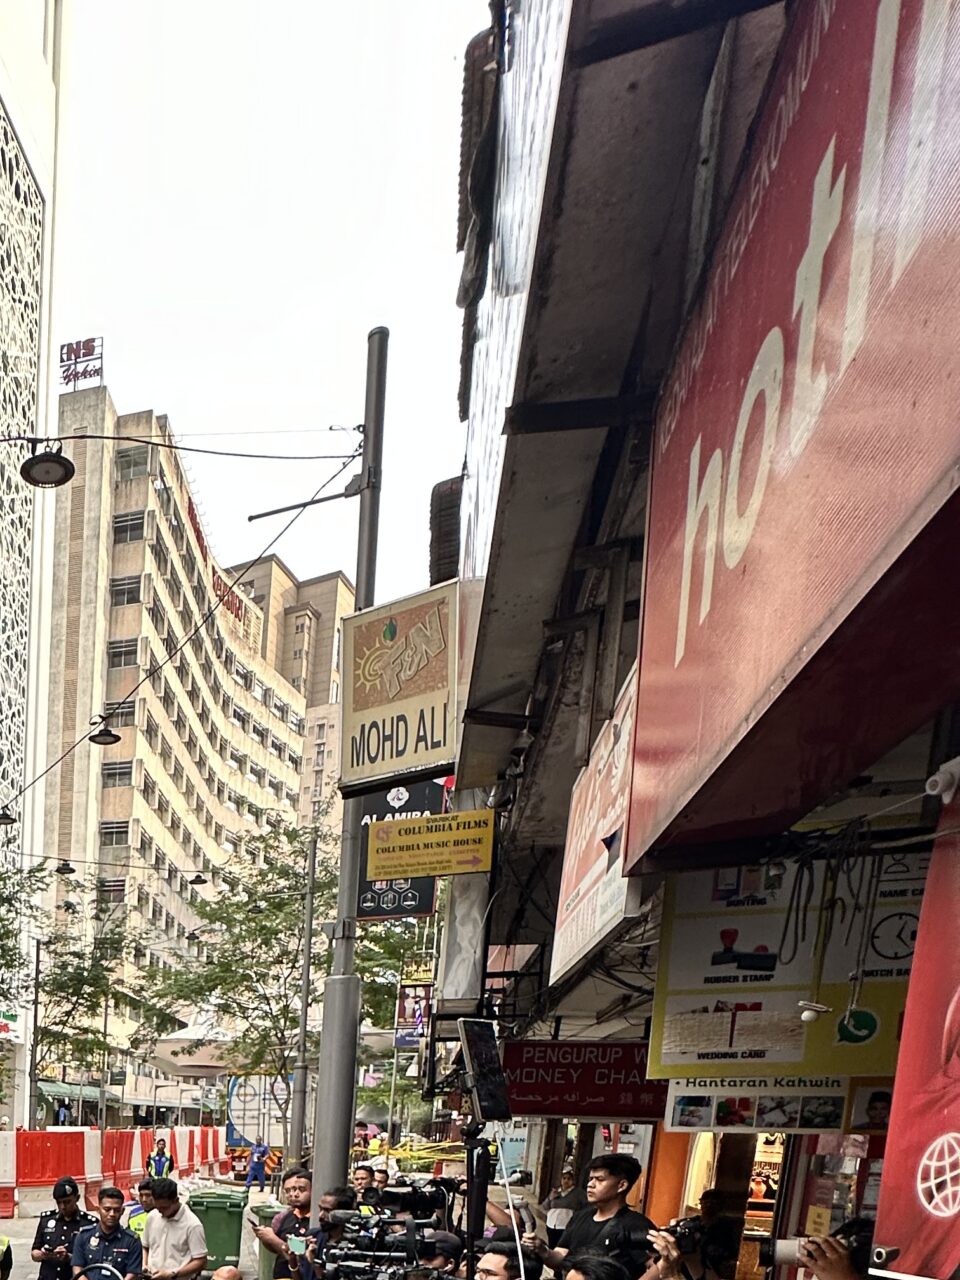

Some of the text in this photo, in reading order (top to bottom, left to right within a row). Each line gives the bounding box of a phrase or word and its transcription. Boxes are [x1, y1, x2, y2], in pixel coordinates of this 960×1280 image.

[351, 702, 447, 768] MOHD ALI
[398, 819, 489, 837] COLUMBIA FILMS
[376, 837, 484, 855] COLUMBIA MUSIC HOUSE
[879, 889, 910, 898] NAME
[704, 973, 775, 984] RUBBER STAMP
[522, 1047, 623, 1064] PENGURUP
[697, 1050, 766, 1060] WEDDING CARD
[506, 1068, 583, 1084] MONEY
[685, 1076, 842, 1089] Hantaran Kahwin
